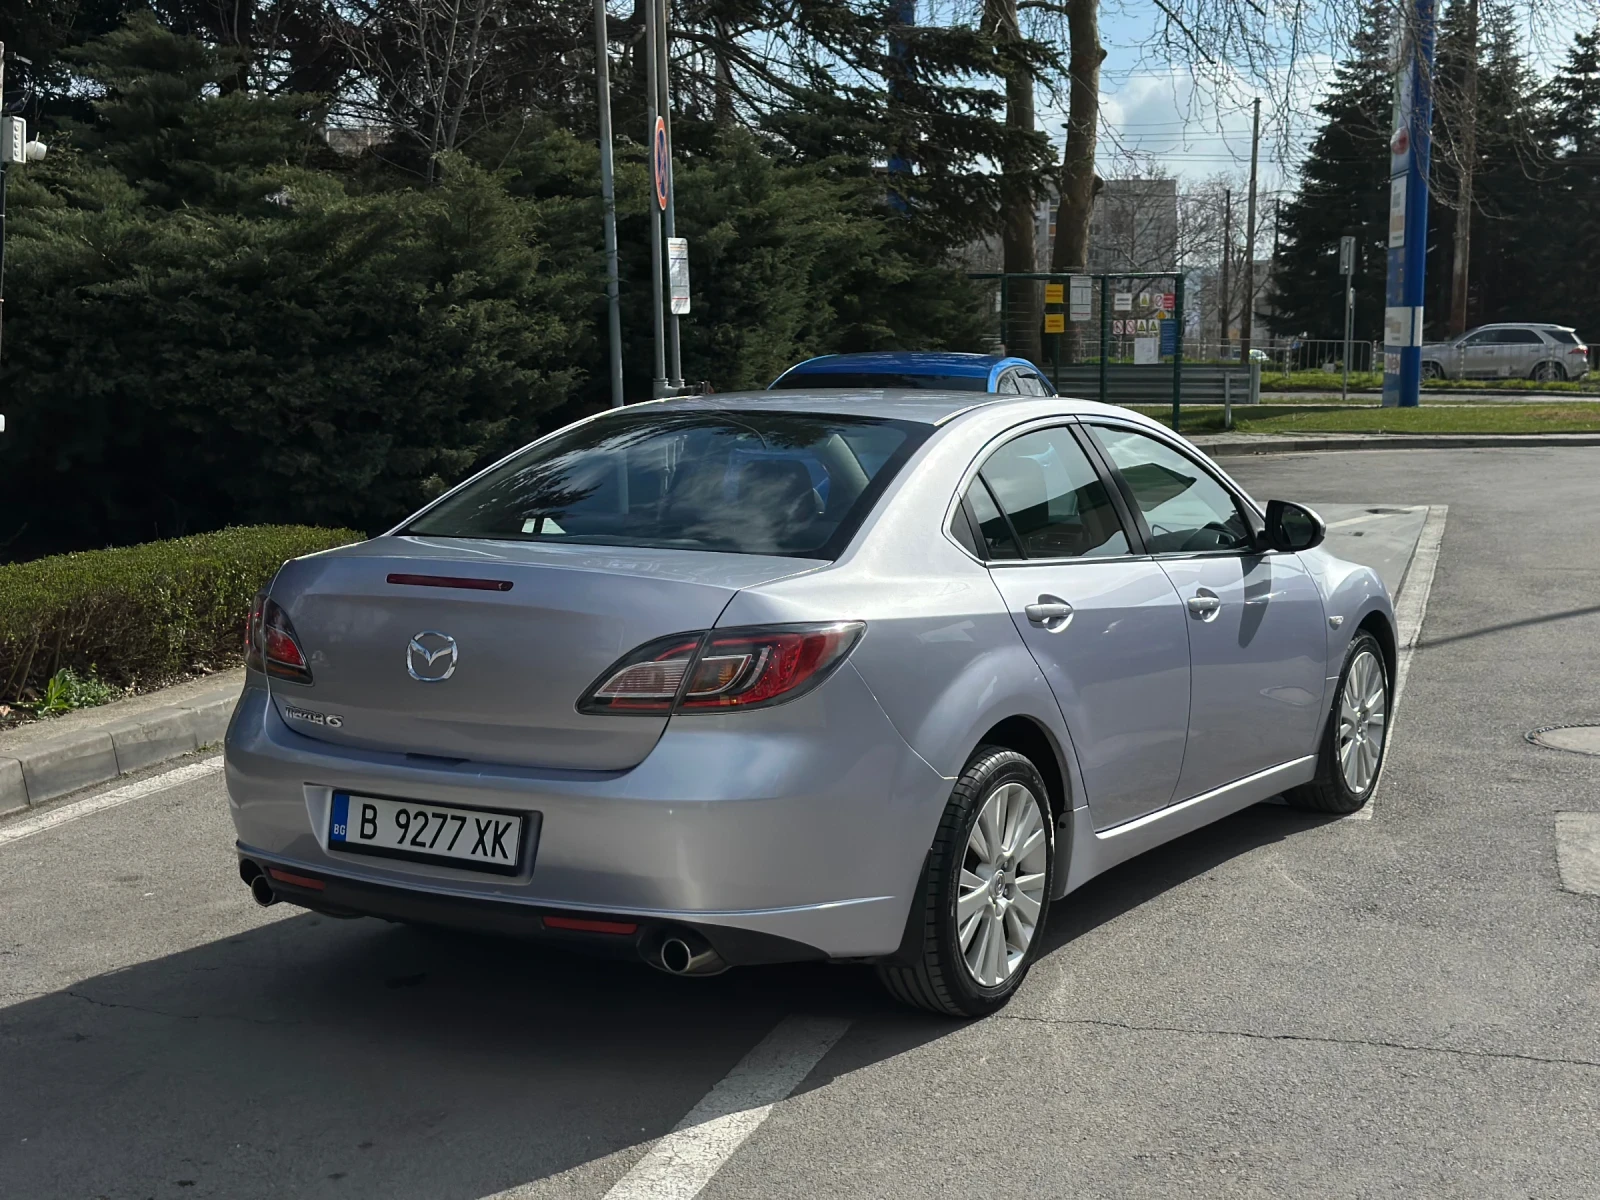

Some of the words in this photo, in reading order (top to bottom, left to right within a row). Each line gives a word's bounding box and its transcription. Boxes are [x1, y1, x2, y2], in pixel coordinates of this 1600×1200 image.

[333, 823, 346, 836] BG
[359, 803, 378, 840] B
[395, 808, 467, 851] 9277
[471, 818, 512, 859] XK
